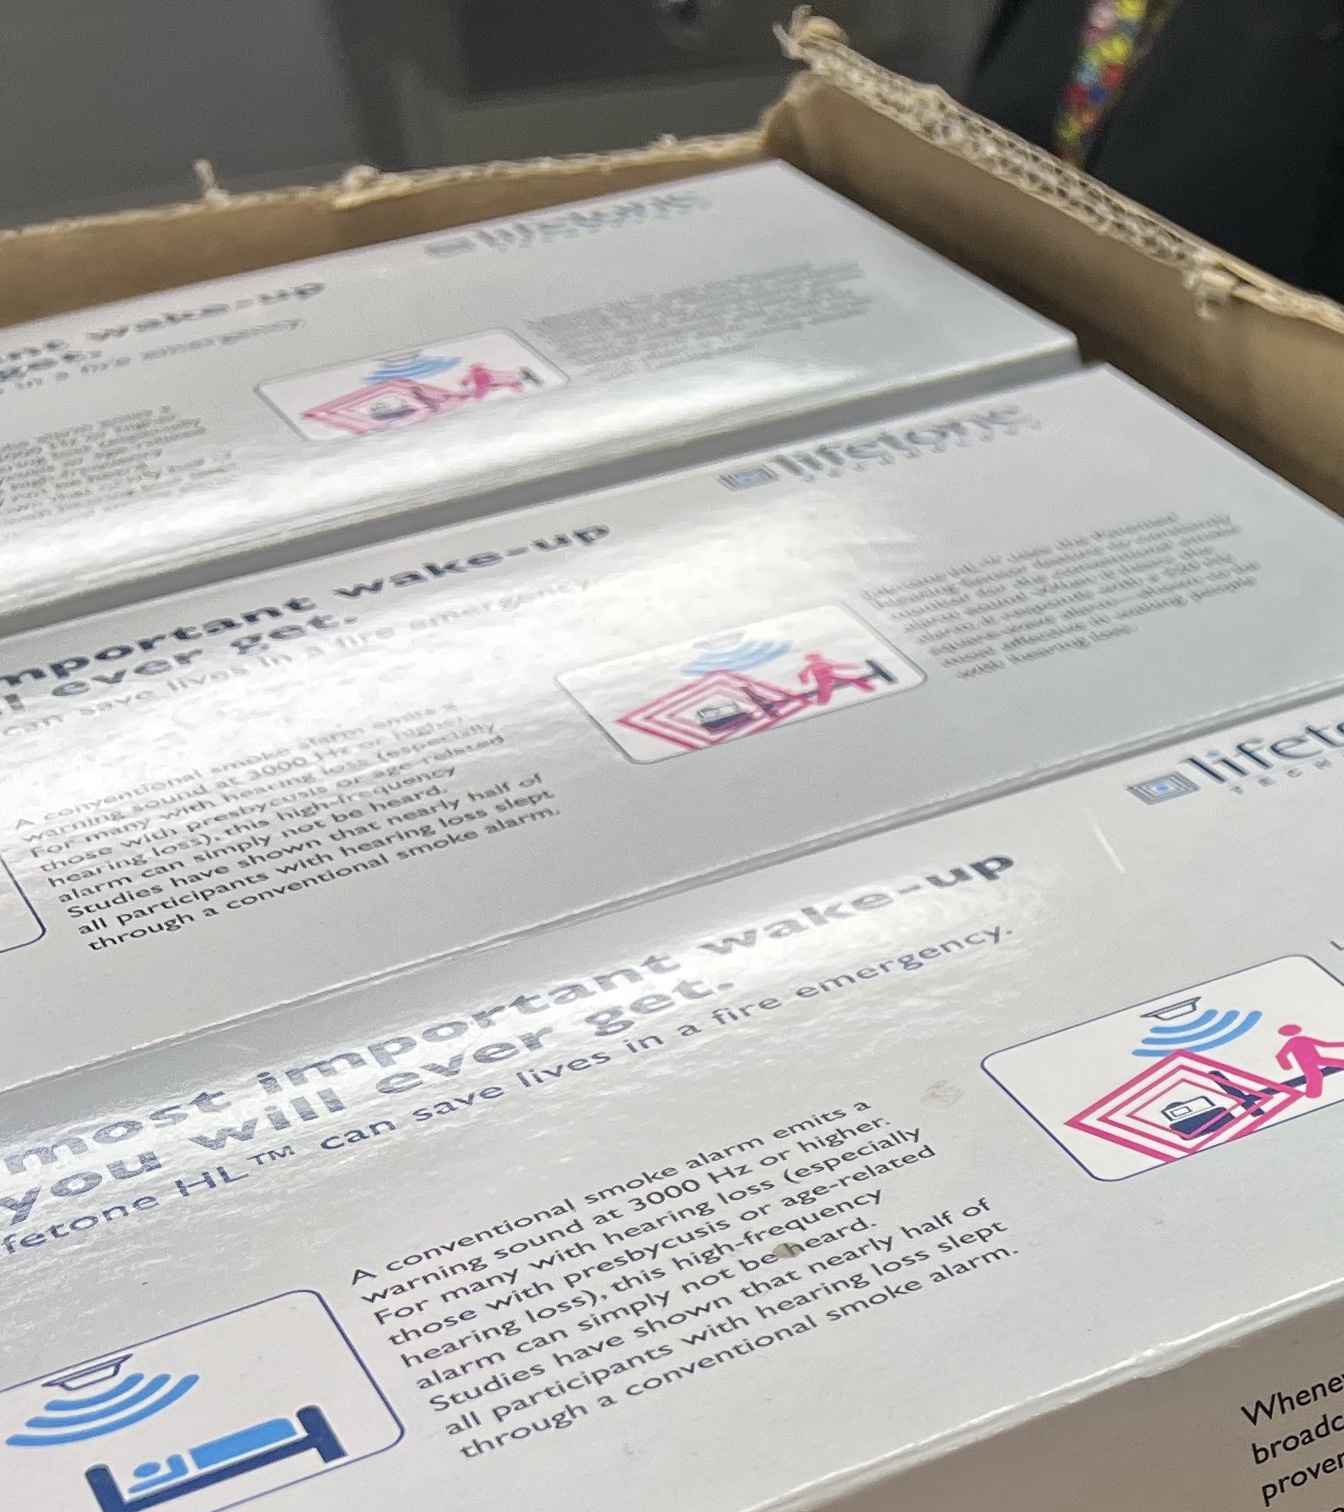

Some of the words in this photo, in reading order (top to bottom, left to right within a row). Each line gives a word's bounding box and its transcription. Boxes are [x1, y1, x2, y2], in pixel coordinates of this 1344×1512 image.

[333, 524, 611, 597] wake-up
[51, 649, 204, 698] ever
[0, 1145, 159, 1223] you
[187, 1088, 347, 1150] will
[375, 1026, 553, 1094] ever
[583, 979, 734, 1037] get.
[1, 1195, 160, 1254] fetone
[319, 1120, 397, 1150] can
[411, 1085, 505, 1122] save
[515, 1051, 612, 1088] lives
[622, 1034, 665, 1053] in
[676, 1024, 703, 1037] a
[711, 997, 782, 1025] fire
[795, 925, 1013, 998] emergency.
[3, 1090, 232, 1175] most
[255, 954, 681, 1093] important
[697, 855, 1014, 955] wake-up
[351, 1268, 377, 1286] A
[385, 1197, 575, 1271] conventional
[584, 1167, 678, 1204] smoke
[685, 1137, 765, 1169] alarm
[772, 1109, 847, 1139] emits
[853, 1101, 871, 1111] a
